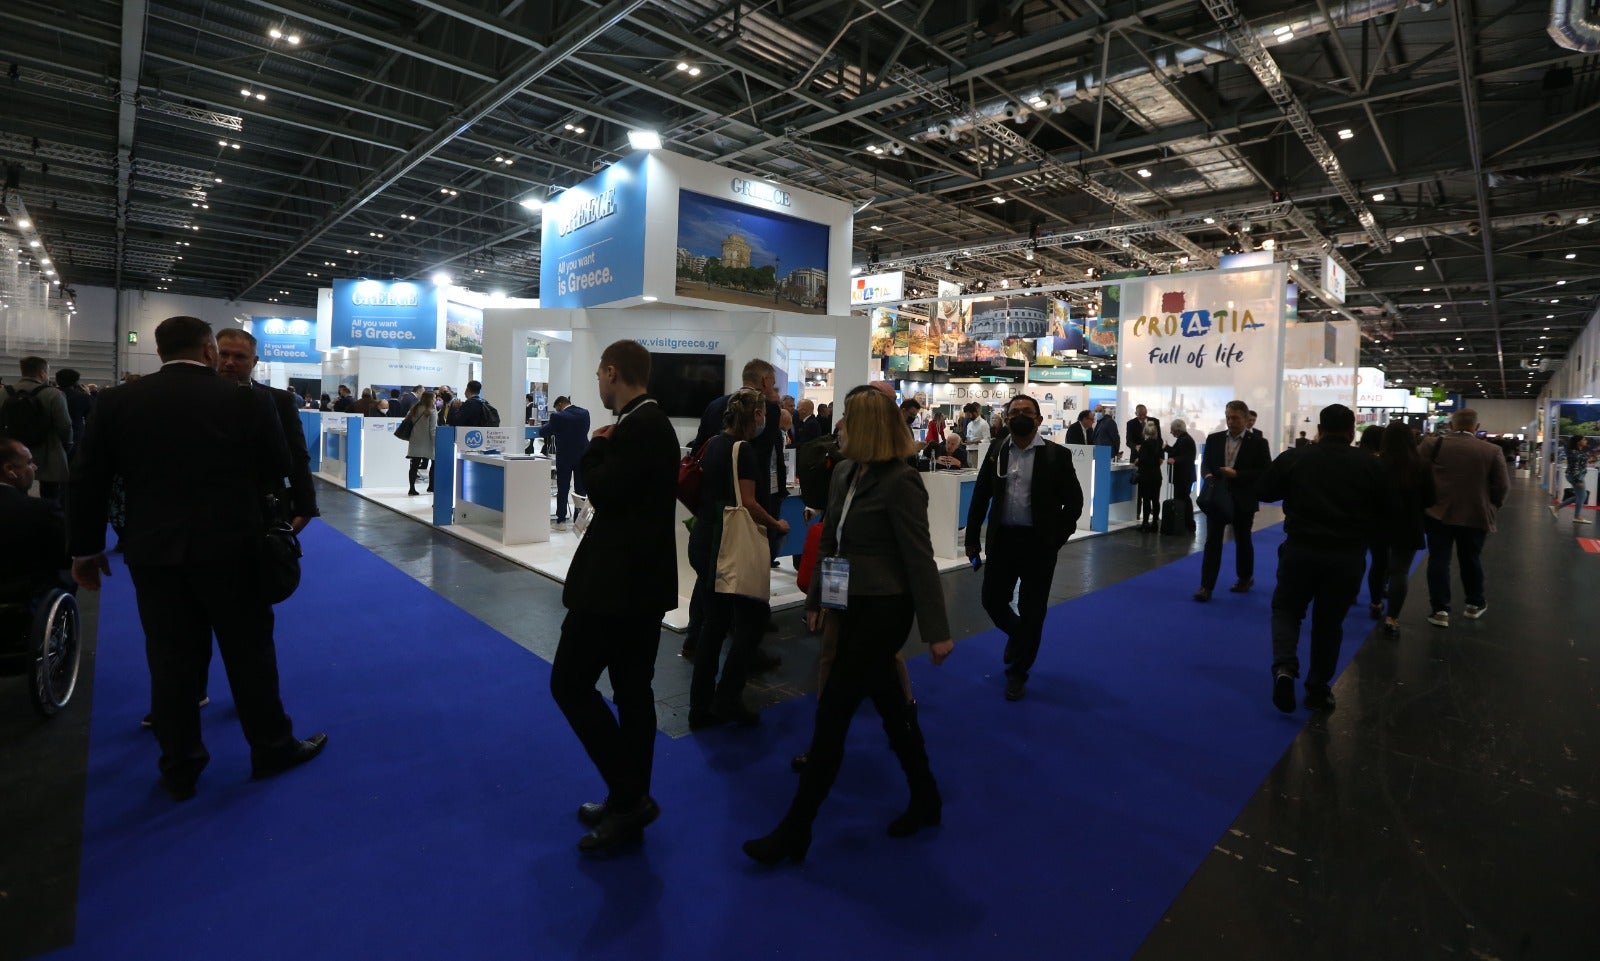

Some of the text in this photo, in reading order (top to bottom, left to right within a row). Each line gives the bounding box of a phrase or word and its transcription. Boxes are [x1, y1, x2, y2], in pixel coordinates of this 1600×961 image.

[731, 177, 791, 207] GRCE
[558, 251, 595, 276] All you want
[558, 266, 613, 296] is Greece.
[852, 286, 892, 301] ROATIA
[363, 320, 377, 329] you
[1133, 309, 1265, 337] CROATIA
[352, 327, 416, 340] is Greece.
[634, 337, 720, 350] w.visitgreece.gr
[264, 349, 308, 358] is Greece.
[1148, 343, 1244, 368] Full of life
[1338, 394, 1383, 403] POAND
